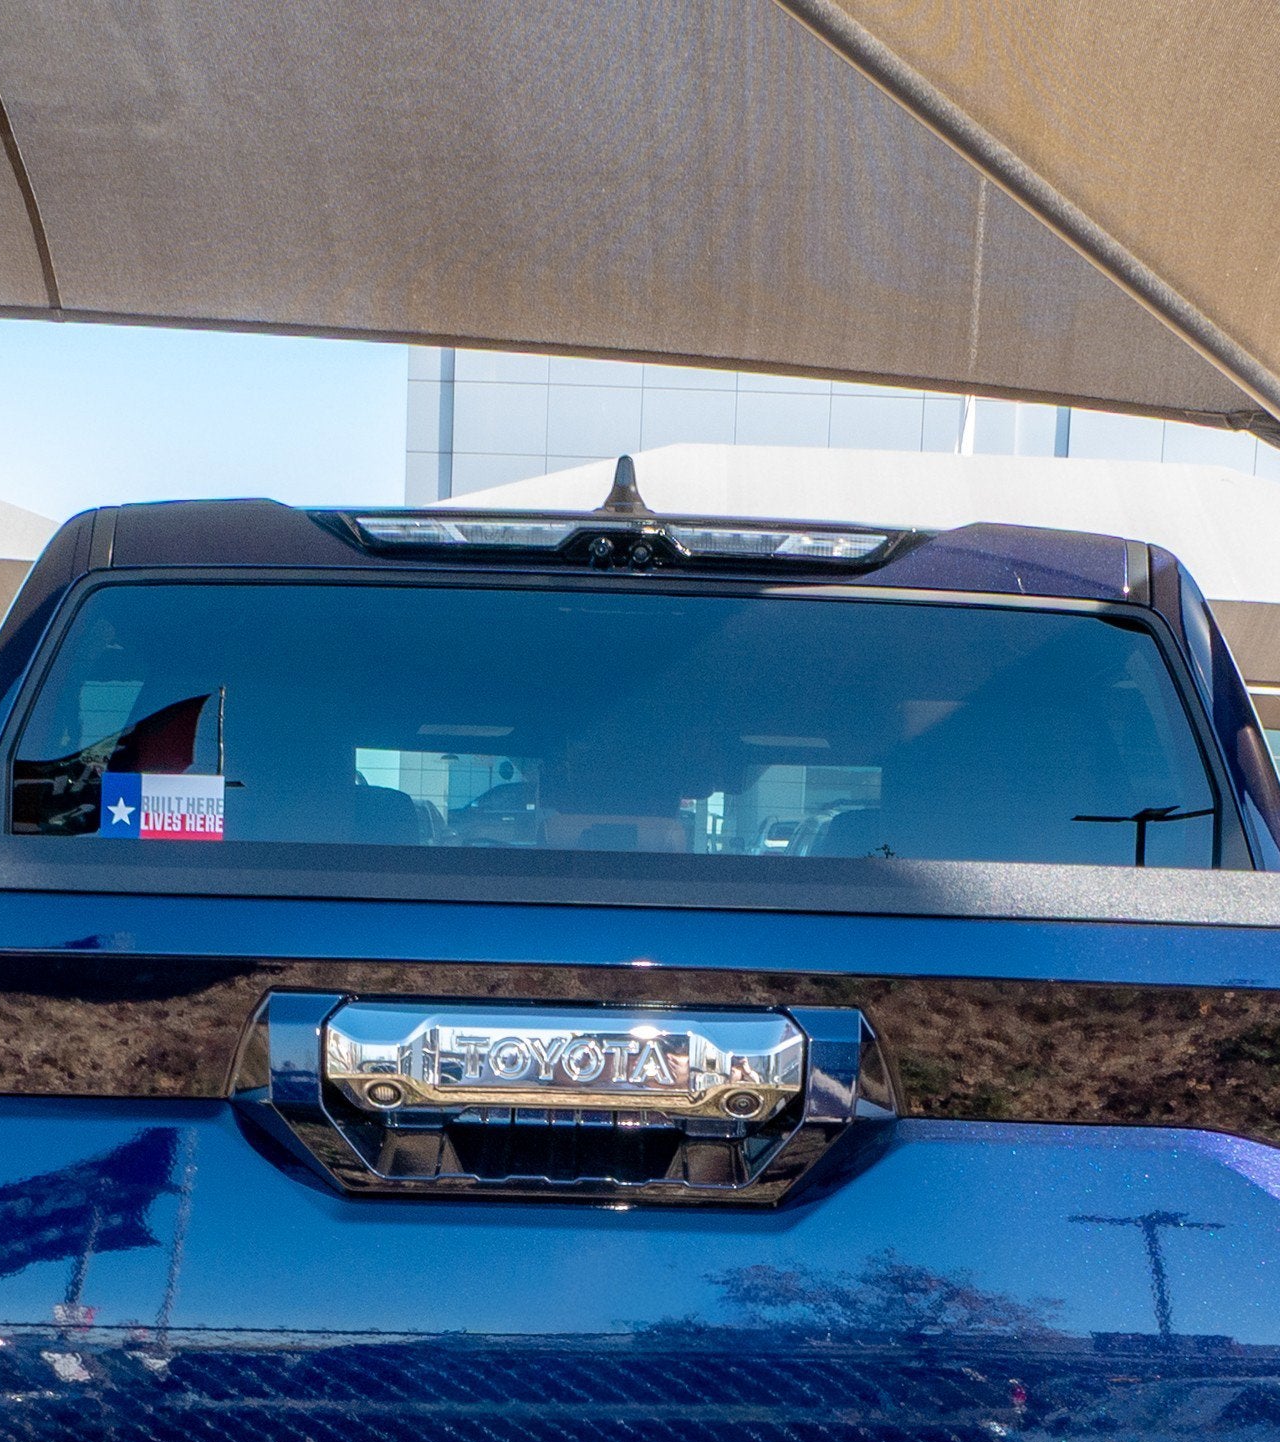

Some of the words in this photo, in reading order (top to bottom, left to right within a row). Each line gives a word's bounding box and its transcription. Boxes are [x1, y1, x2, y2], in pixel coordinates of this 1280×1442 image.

[142, 796, 183, 813] BUILT
[186, 797, 224, 815] HERE
[141, 811, 182, 832] LIVES
[186, 813, 224, 833] HERE
[454, 1035, 675, 1084] TOYOTA
